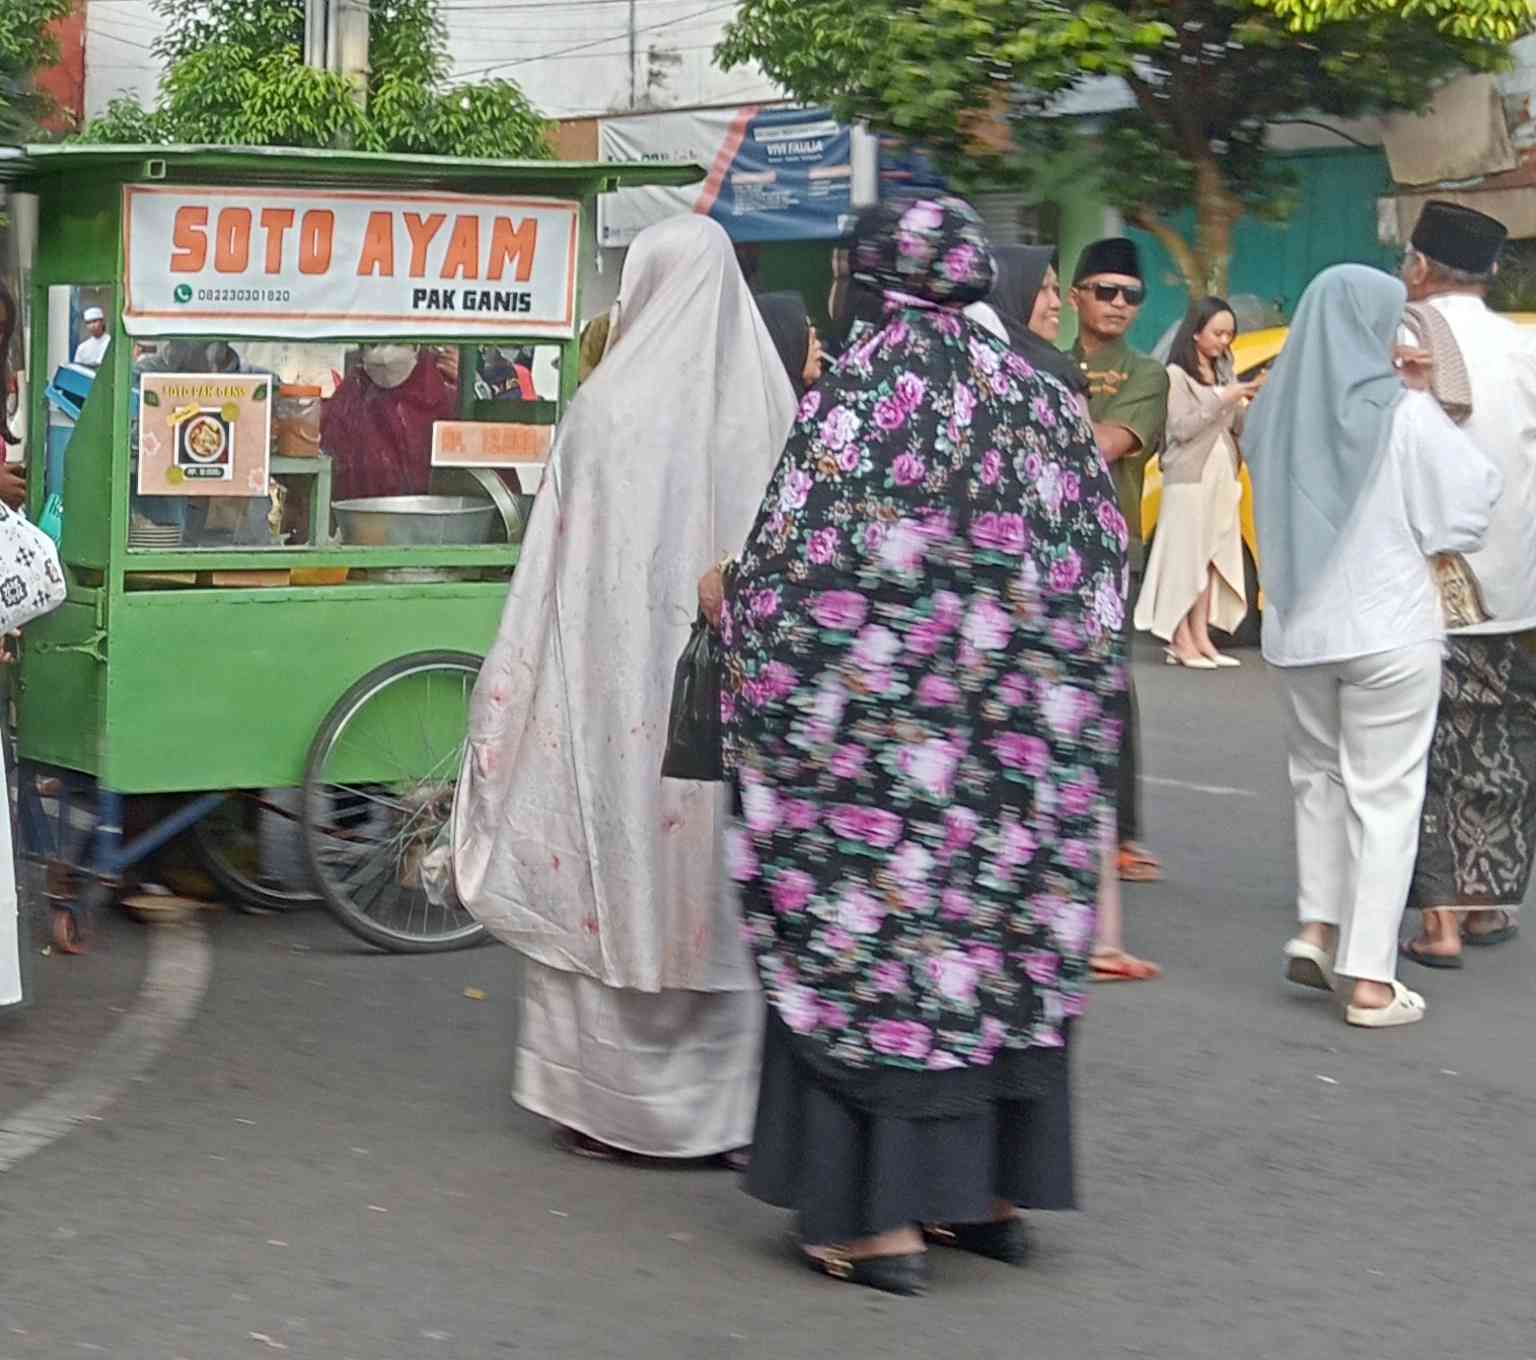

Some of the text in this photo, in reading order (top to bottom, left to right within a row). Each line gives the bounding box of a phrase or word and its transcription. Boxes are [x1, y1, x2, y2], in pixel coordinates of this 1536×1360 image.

[170, 206, 538, 282] SOTO AYAM
[413, 288, 531, 312] PAK GANIS
